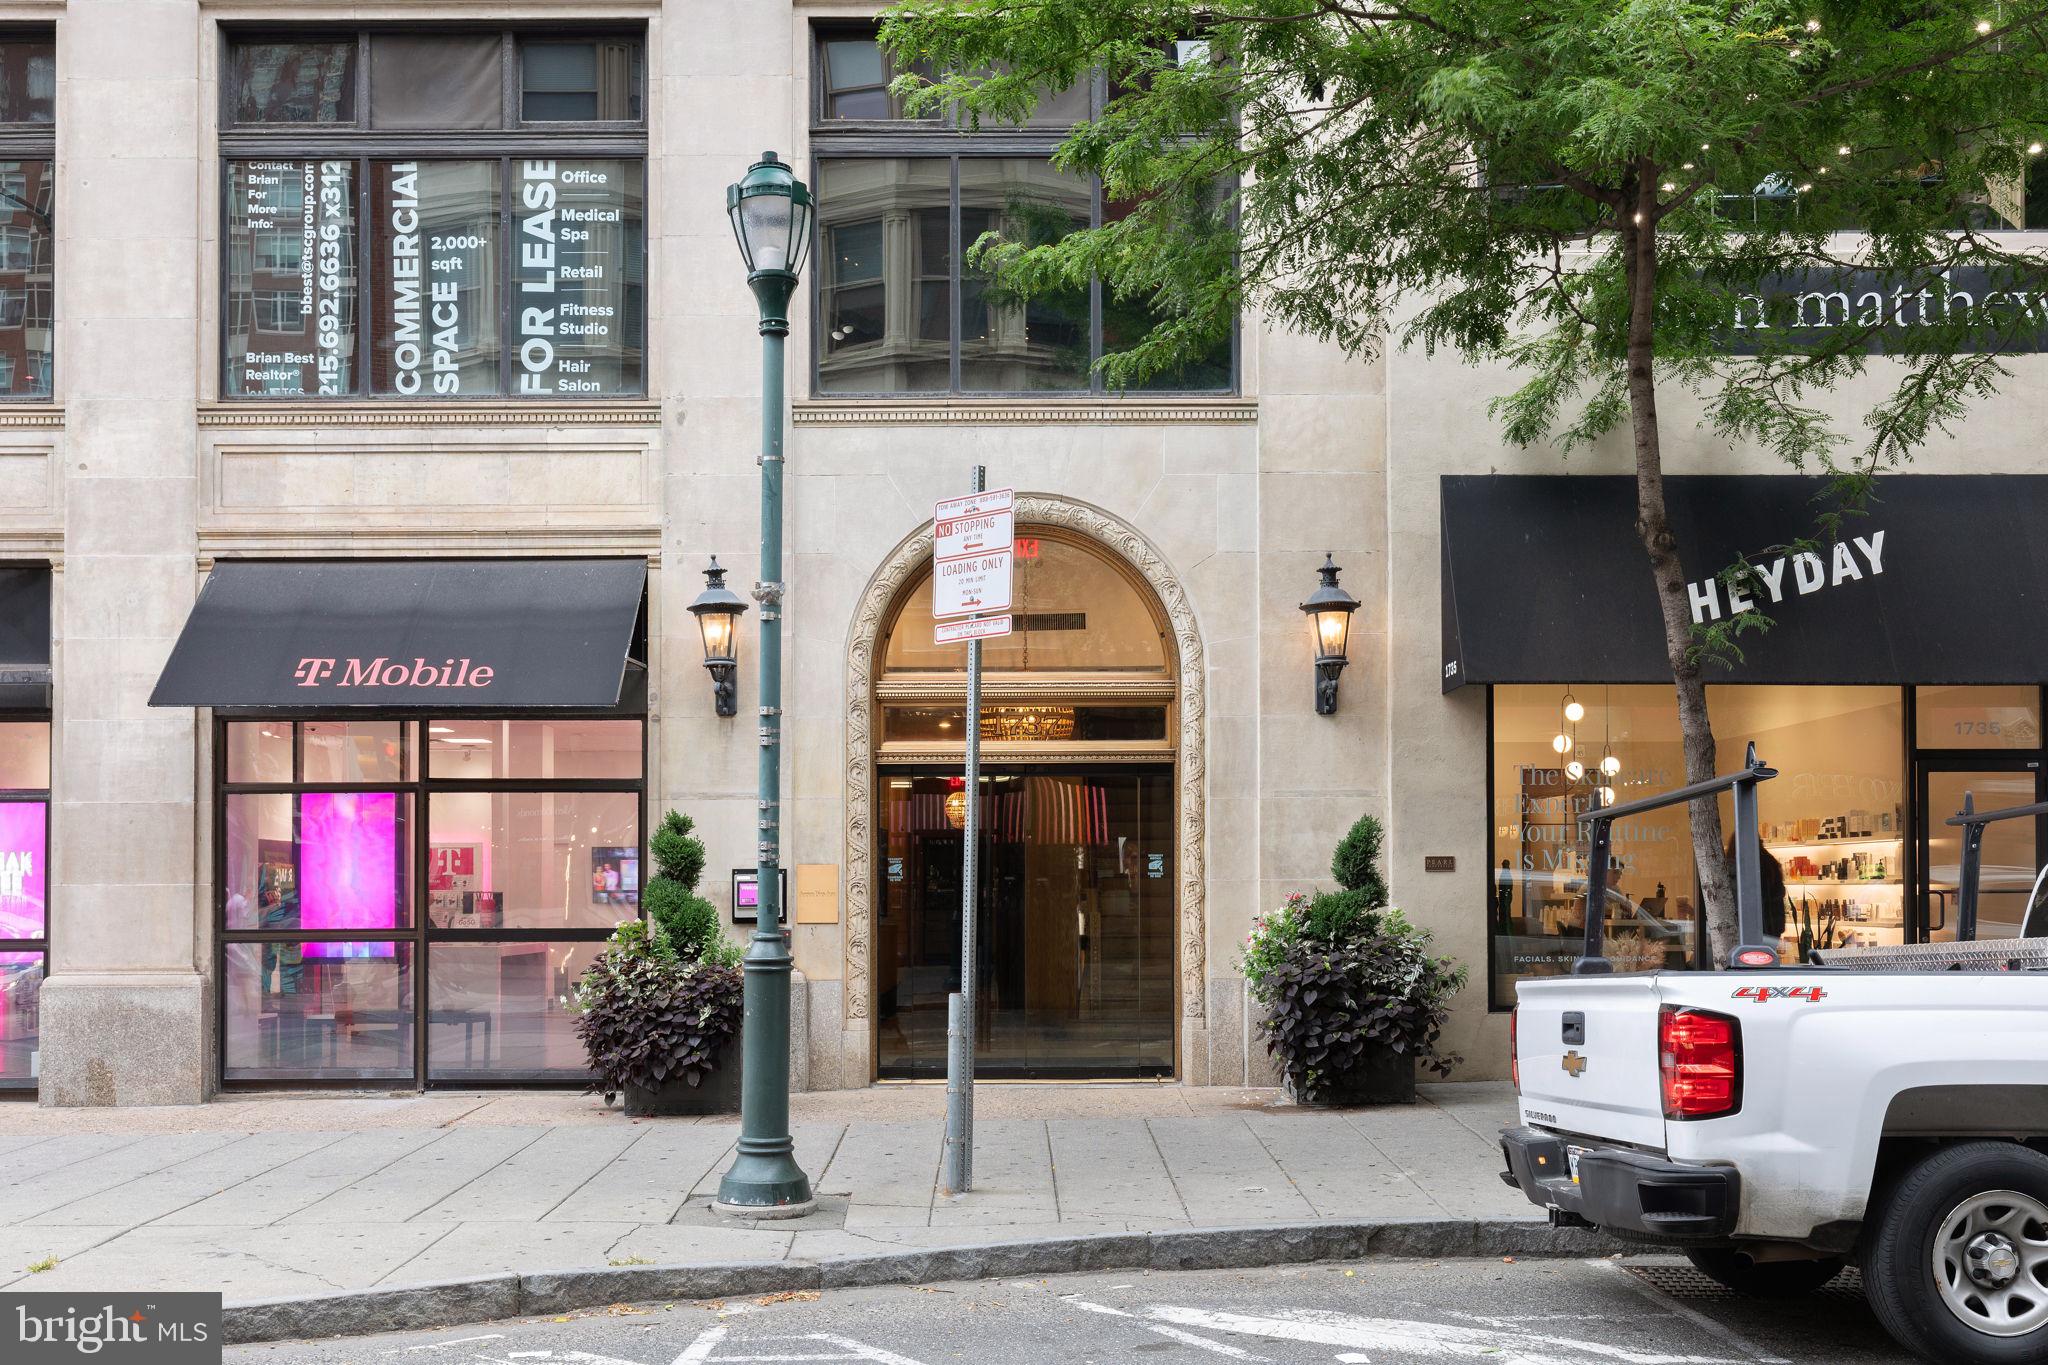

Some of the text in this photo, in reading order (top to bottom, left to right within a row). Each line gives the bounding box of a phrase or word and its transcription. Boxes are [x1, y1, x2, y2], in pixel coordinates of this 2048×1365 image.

[248, 161, 293, 170] Contact
[248, 175, 279, 185] Brian
[561, 170, 607, 184] Office
[248, 190, 267, 199] For
[247, 205, 278, 214] More
[561, 209, 620, 222] Medical
[247, 219, 274, 228] Info:
[560, 228, 589, 243] Spa
[431, 236, 487, 251] 2,000+
[431, 257, 463, 273] sqft
[560, 265, 603, 279] Retail
[392, 161, 422, 395] COMMERCIAL
[520, 159, 557, 395] FOR LEASE
[318, 224, 341, 396] 215.692.6636
[560, 303, 614, 317] Fitness
[559, 322, 609, 336] Studio
[431, 282, 460, 394] SPACE
[245, 352, 315, 364] Brian Best
[558, 360, 591, 373] Hair
[558, 379, 601, 392] Salon
[938, 517, 995, 536] NO STOPPING
[973, 533, 983, 541] TIME
[942, 557, 1004, 577] LOADING ONLY
[1687, 530, 1885, 624] HEYDAY
[337, 658, 494, 687] Mobile
[1954, 720, 2001, 737] 1735
[1513, 764, 1559, 786] The
[1512, 820, 1670, 843] Your Rutine
[1515, 849, 1535, 871] Is
[1524, 1109, 1557, 1124] SILVERADO
